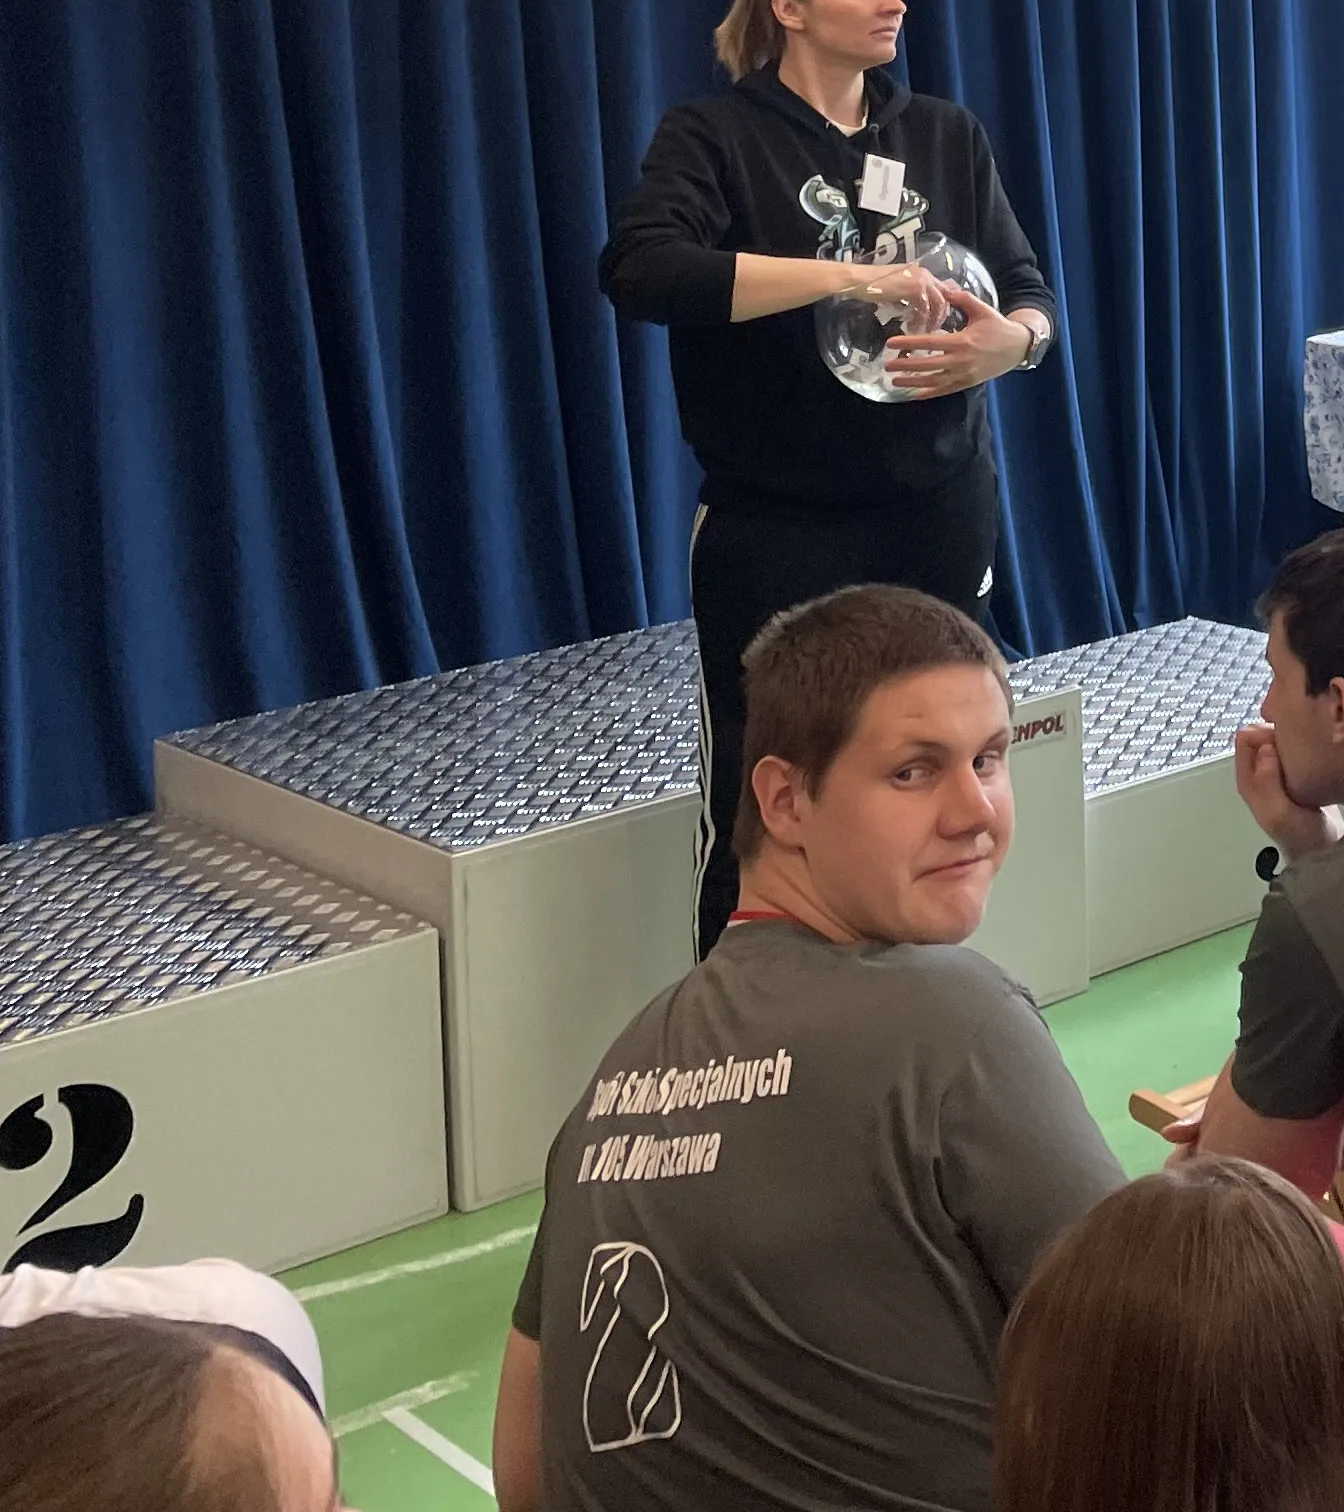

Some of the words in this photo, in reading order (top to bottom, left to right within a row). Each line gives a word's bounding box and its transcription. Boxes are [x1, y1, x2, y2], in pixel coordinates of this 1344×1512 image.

[1011, 714, 1064, 744] NPOL
[653, 1048, 792, 1116] Specjalnych
[0, 1083, 144, 1273] 2
[622, 1133, 721, 1180] Warszawa
[578, 1241, 682, 1453] 2
